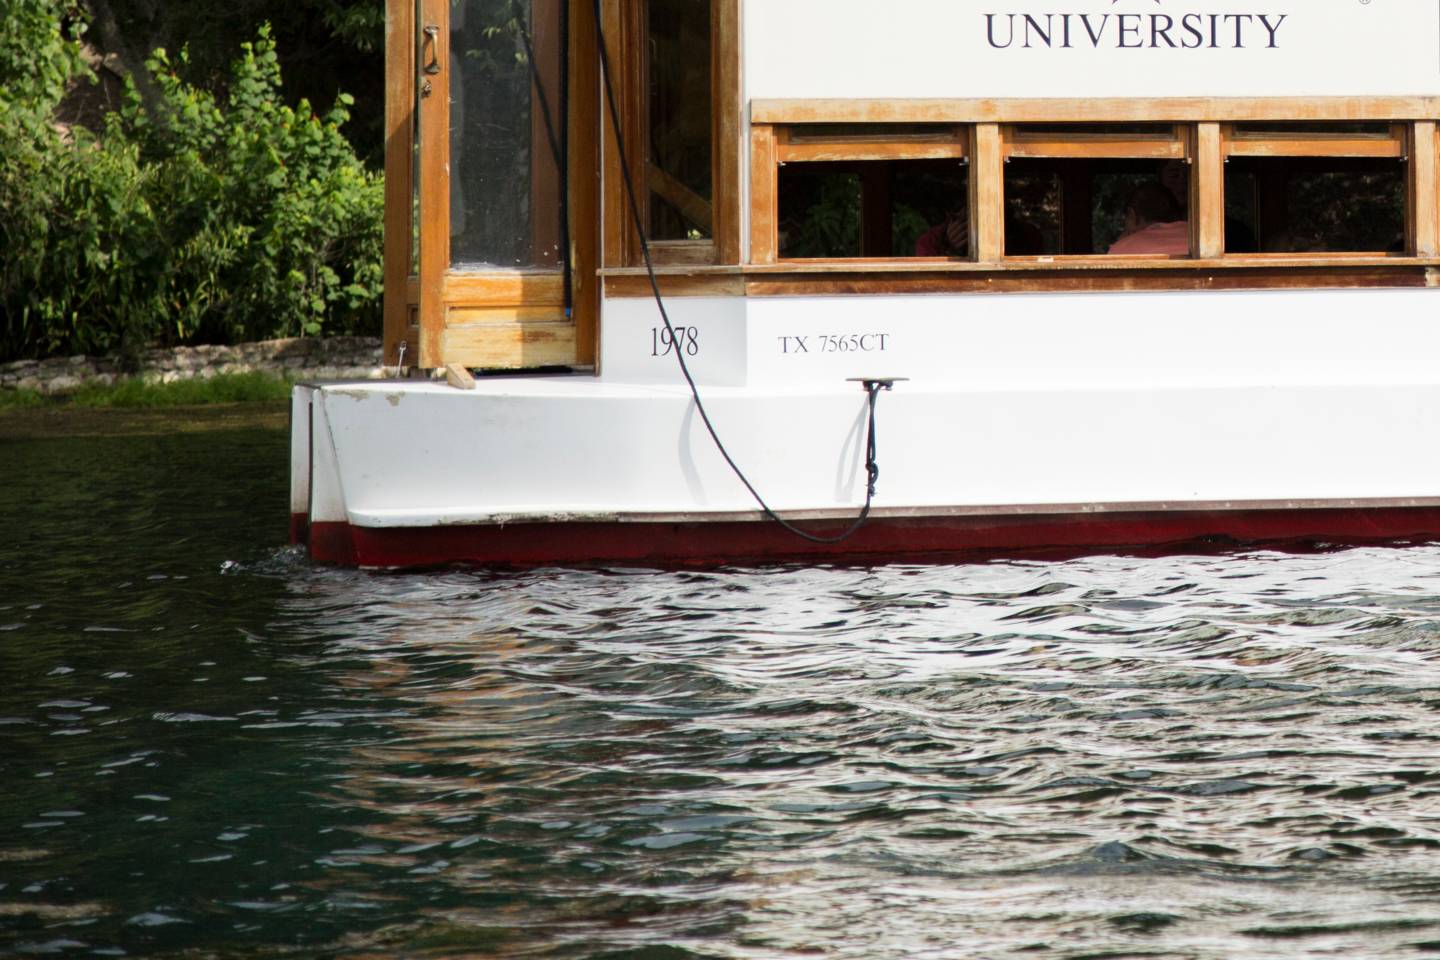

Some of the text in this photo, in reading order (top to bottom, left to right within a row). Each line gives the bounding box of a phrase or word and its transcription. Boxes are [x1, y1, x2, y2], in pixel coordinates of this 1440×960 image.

[984, 14, 1288, 49] UNIVERSITY
[650, 326, 699, 356] 1978
[777, 333, 890, 354] TX 7565CT
